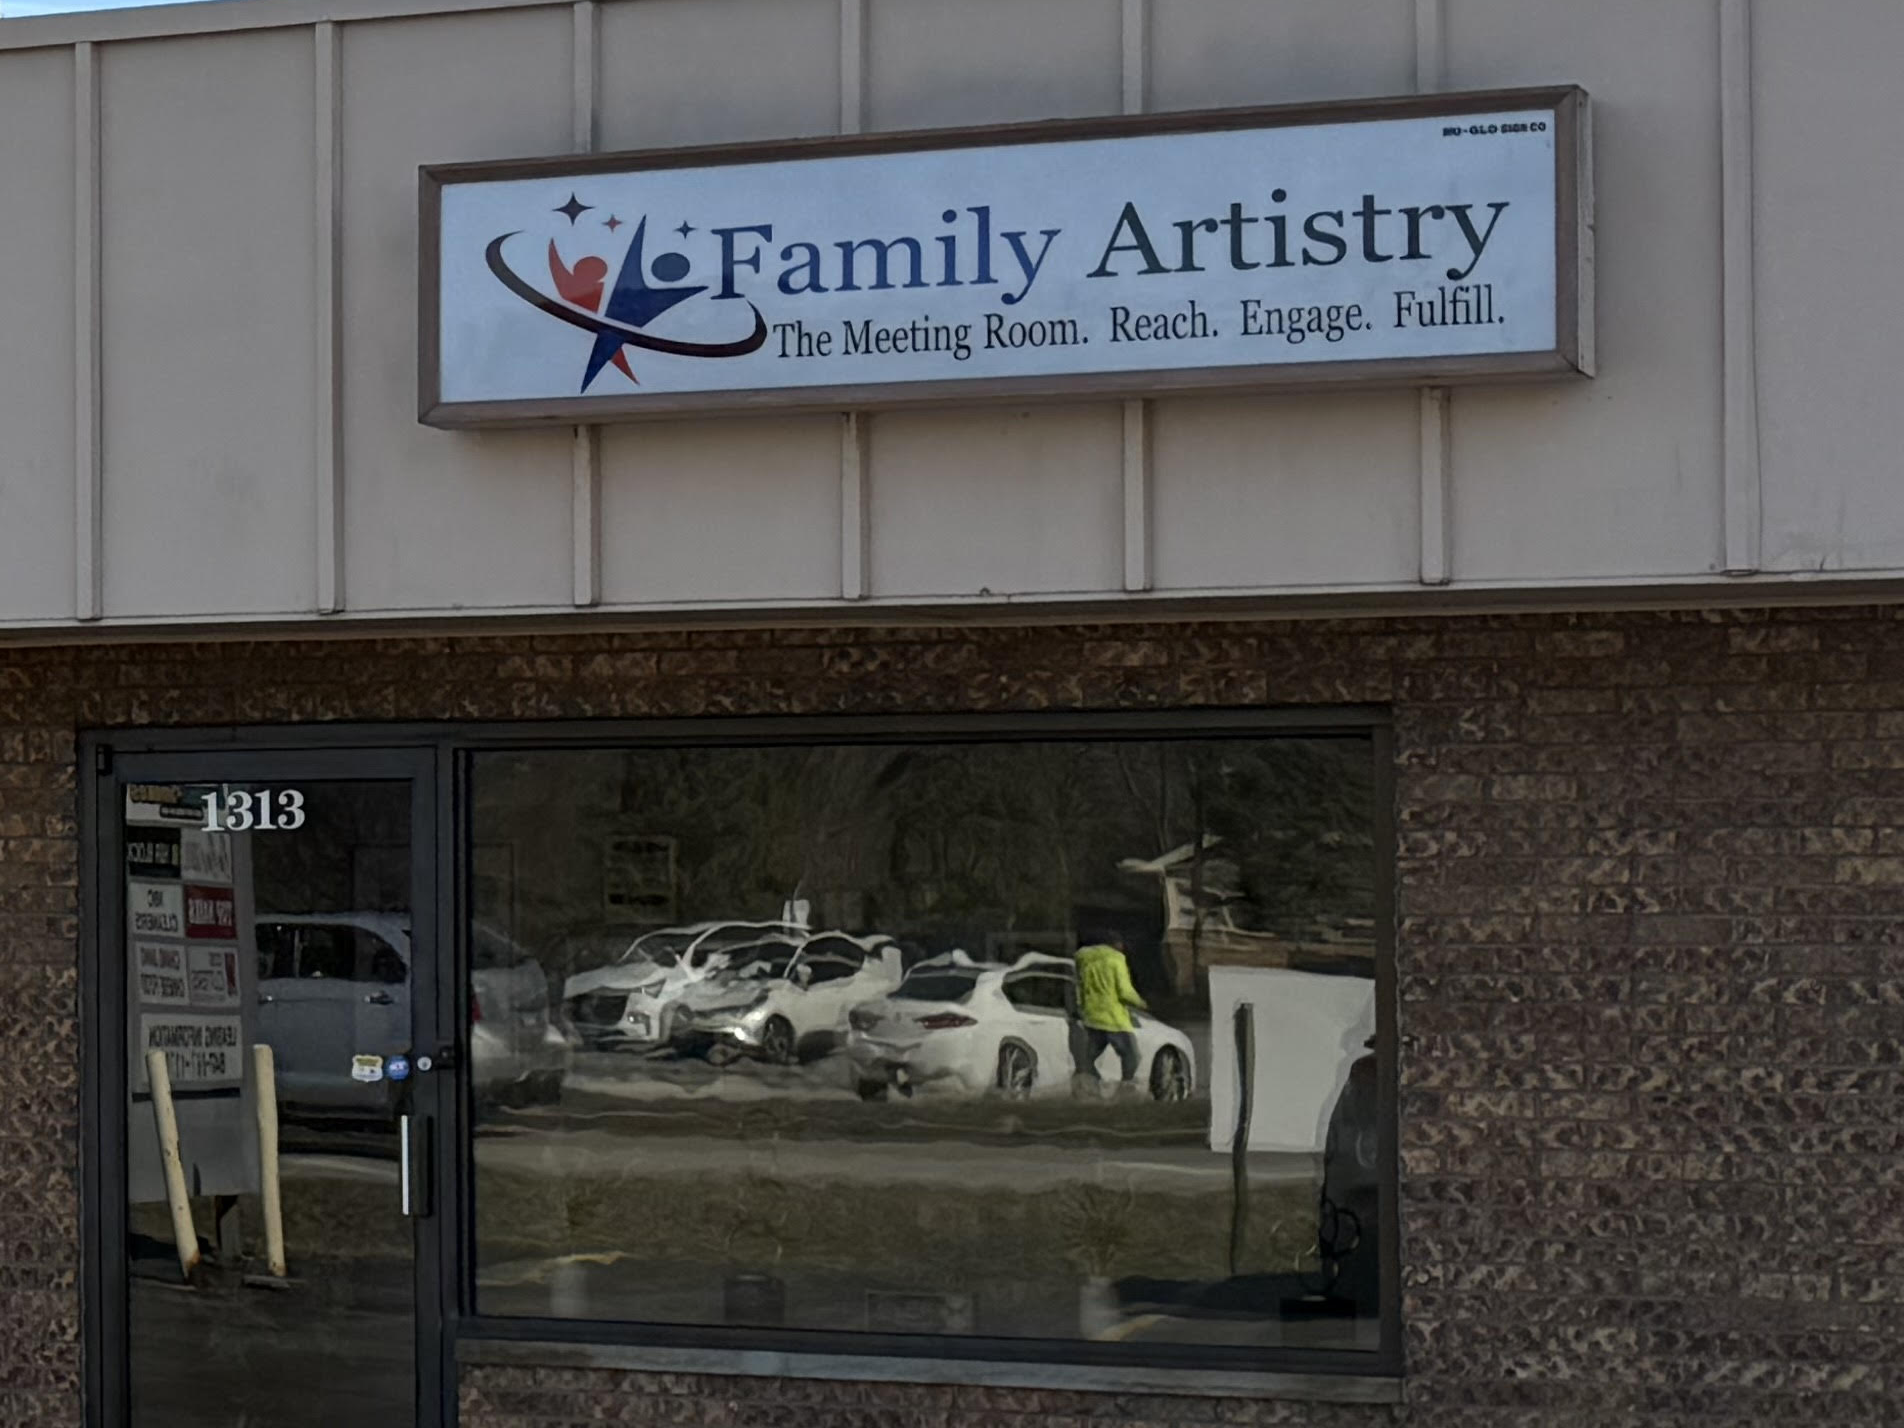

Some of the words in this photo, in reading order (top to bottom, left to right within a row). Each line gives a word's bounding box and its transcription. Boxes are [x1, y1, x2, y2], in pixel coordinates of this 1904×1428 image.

[1443, 123, 1497, 136] NU-GLO
[1530, 121, 1546, 132] CO
[710, 206, 1060, 304] Family
[1086, 188, 1510, 281] Artistry
[772, 322, 833, 359] The
[842, 318, 972, 360] Meeting
[983, 314, 1089, 350] Room.
[1109, 306, 1219, 343] Reach.
[1240, 299, 1372, 342] Engage.
[1393, 285, 1505, 329] Fulfill.
[201, 789, 306, 832] 1313
